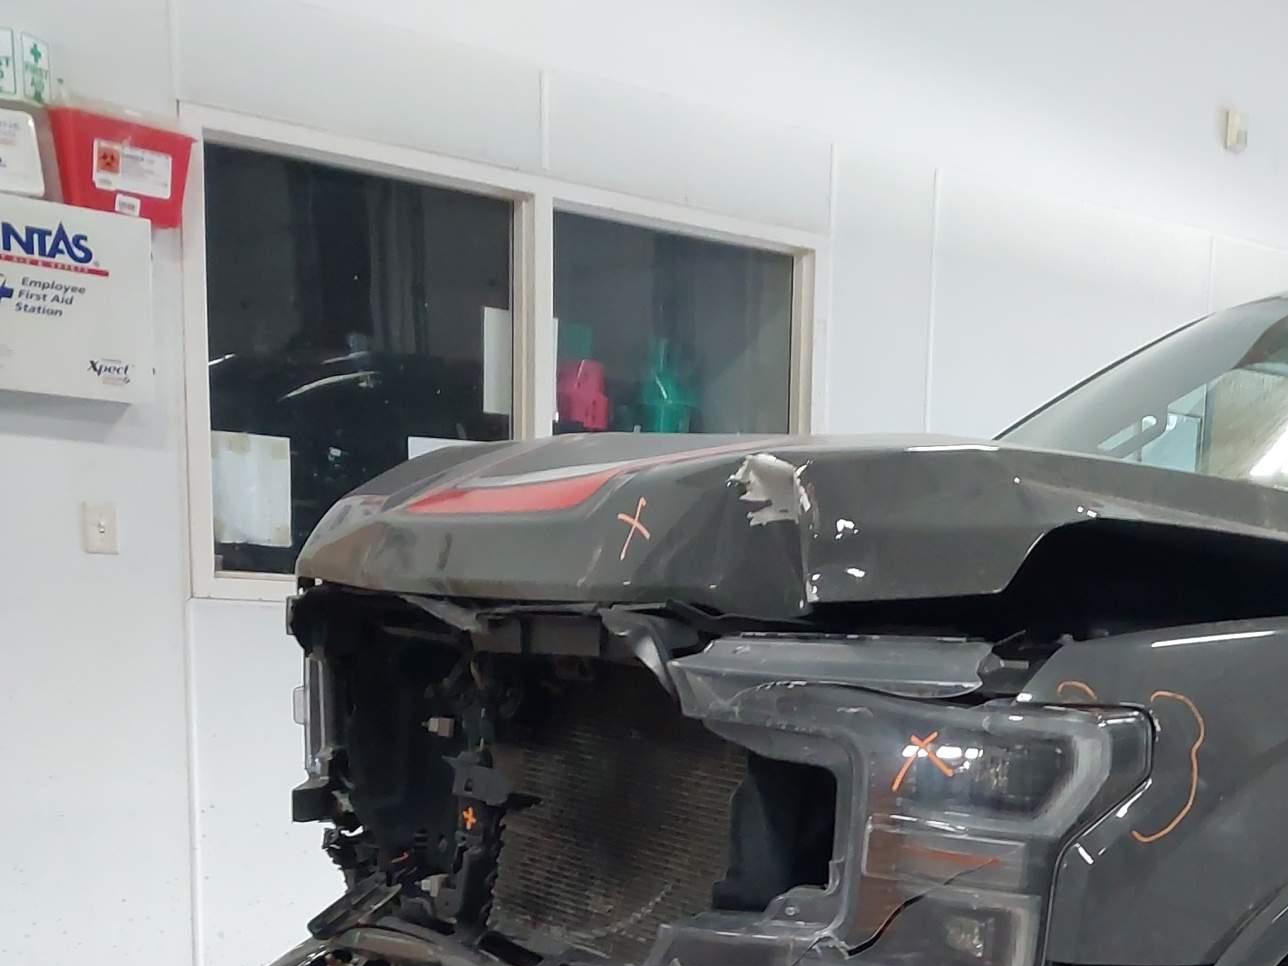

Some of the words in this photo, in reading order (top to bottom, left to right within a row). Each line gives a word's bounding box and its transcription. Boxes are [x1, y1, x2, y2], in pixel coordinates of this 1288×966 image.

[21, 277, 86, 295] Employee
[18, 289, 47, 302] First
[51, 294, 73, 305] Aid
[15, 302, 63, 316] Station
